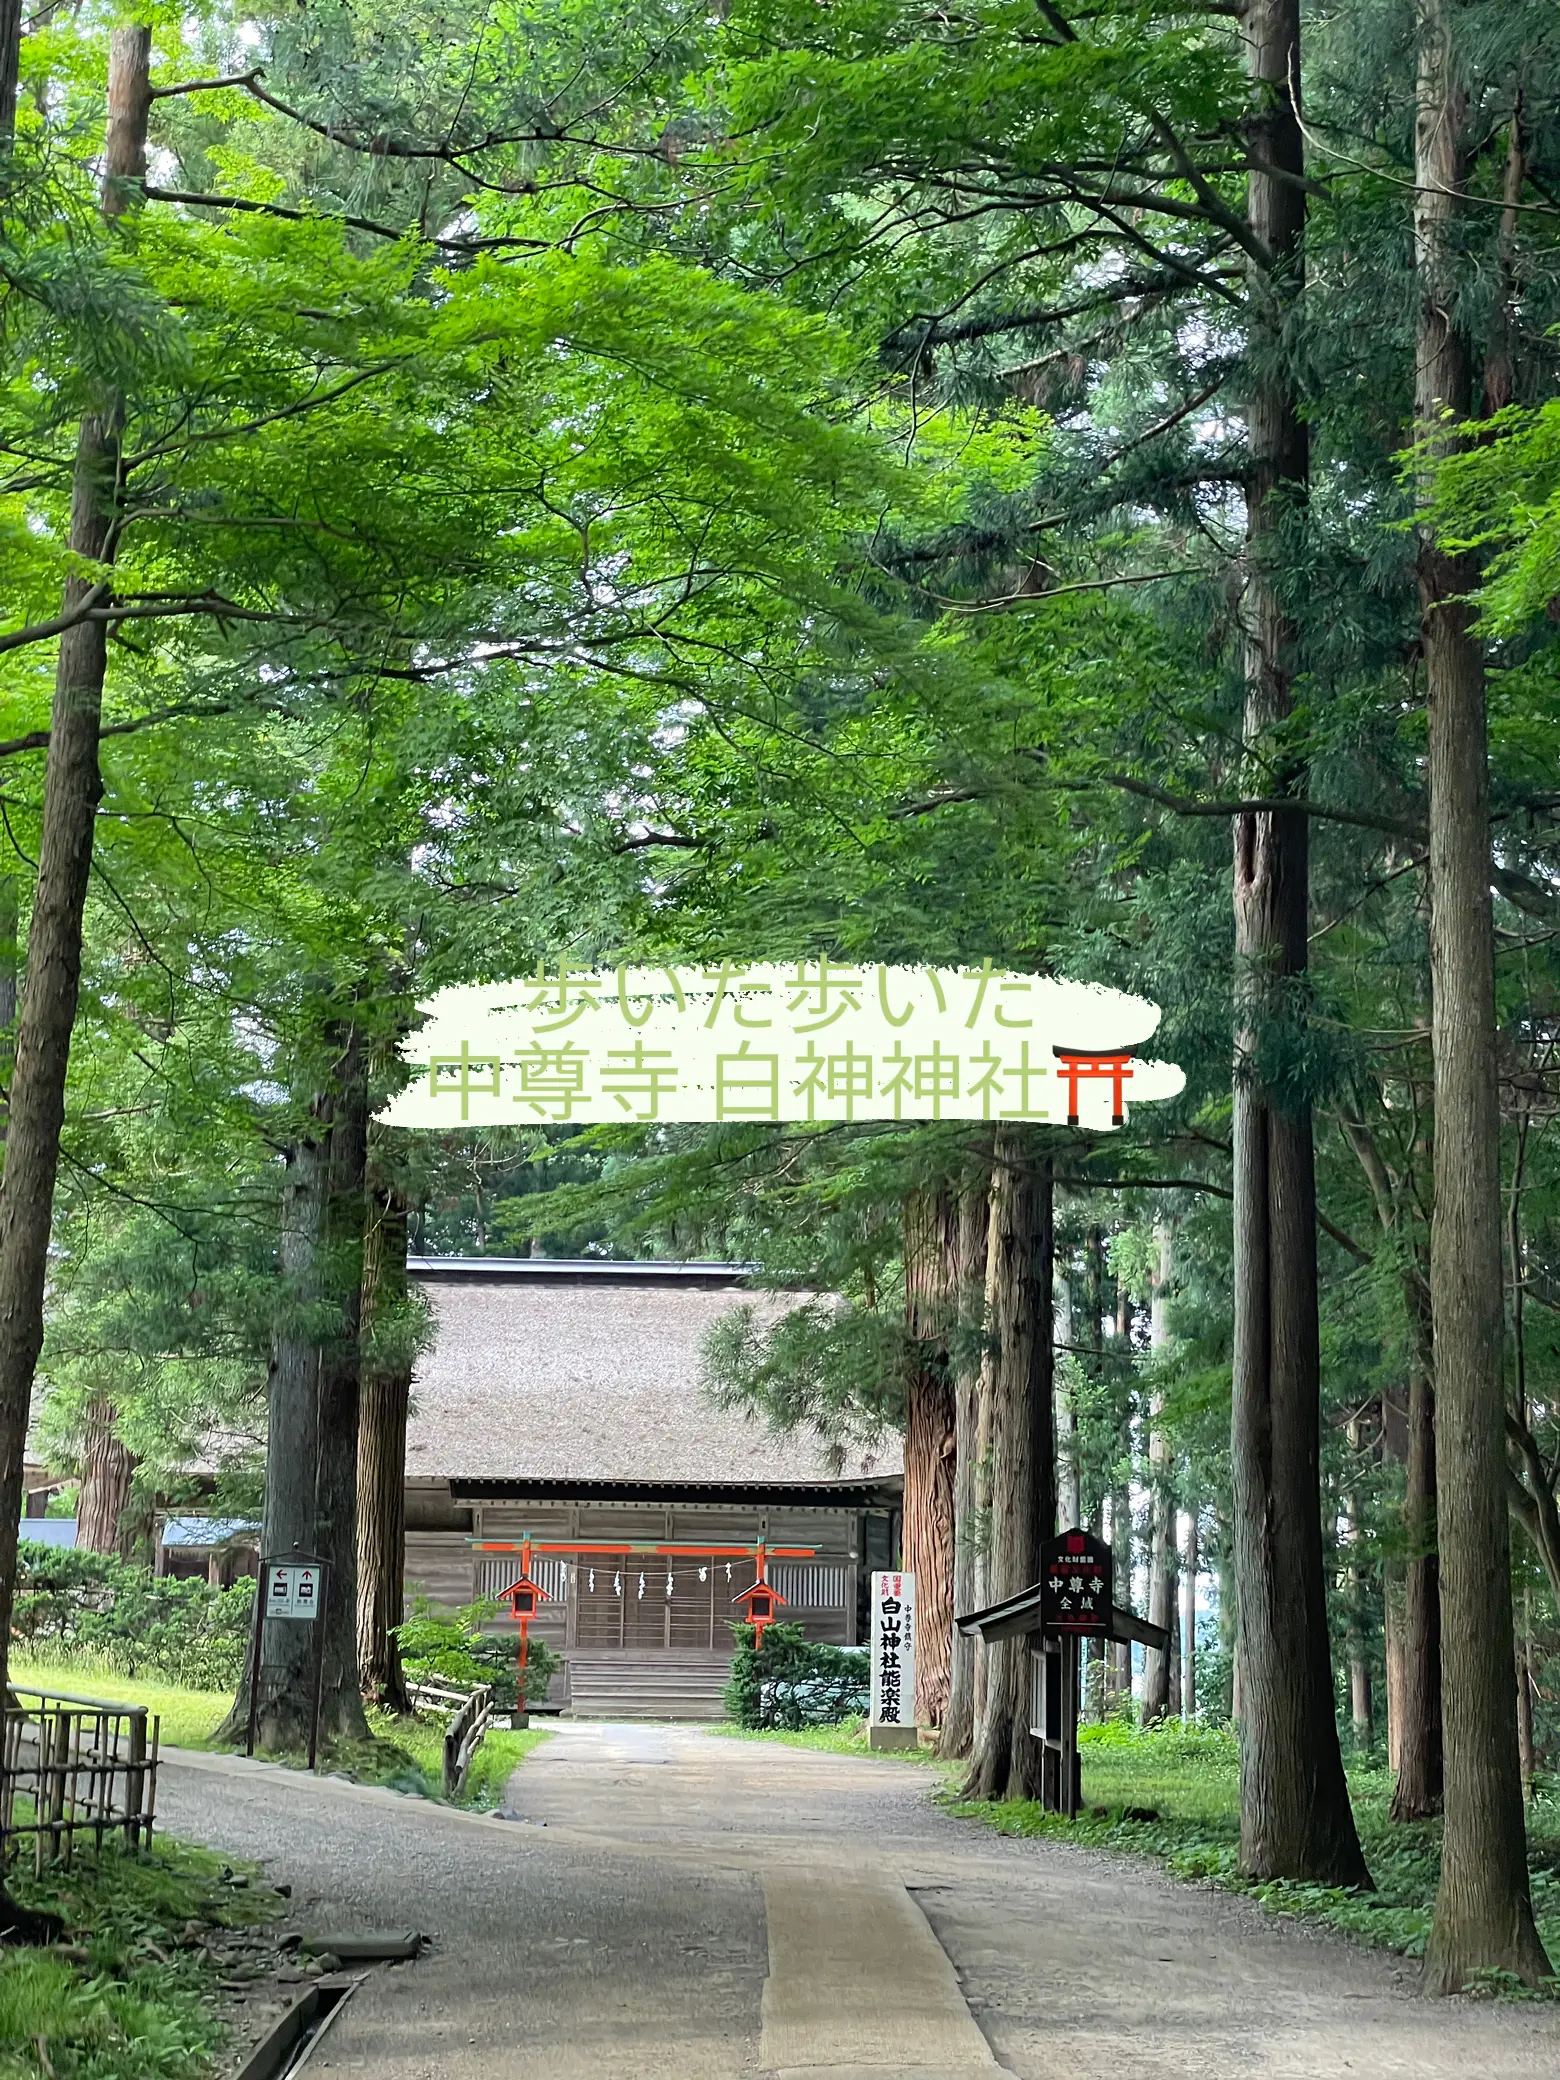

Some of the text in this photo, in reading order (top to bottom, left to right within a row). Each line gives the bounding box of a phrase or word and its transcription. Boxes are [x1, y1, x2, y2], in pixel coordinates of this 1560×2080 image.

[1048, 1575, 1105, 1595] 中尊寺
[1060, 1596, 1094, 1610] 全域
[879, 1597, 902, 1724] 白山神社能楽殿
